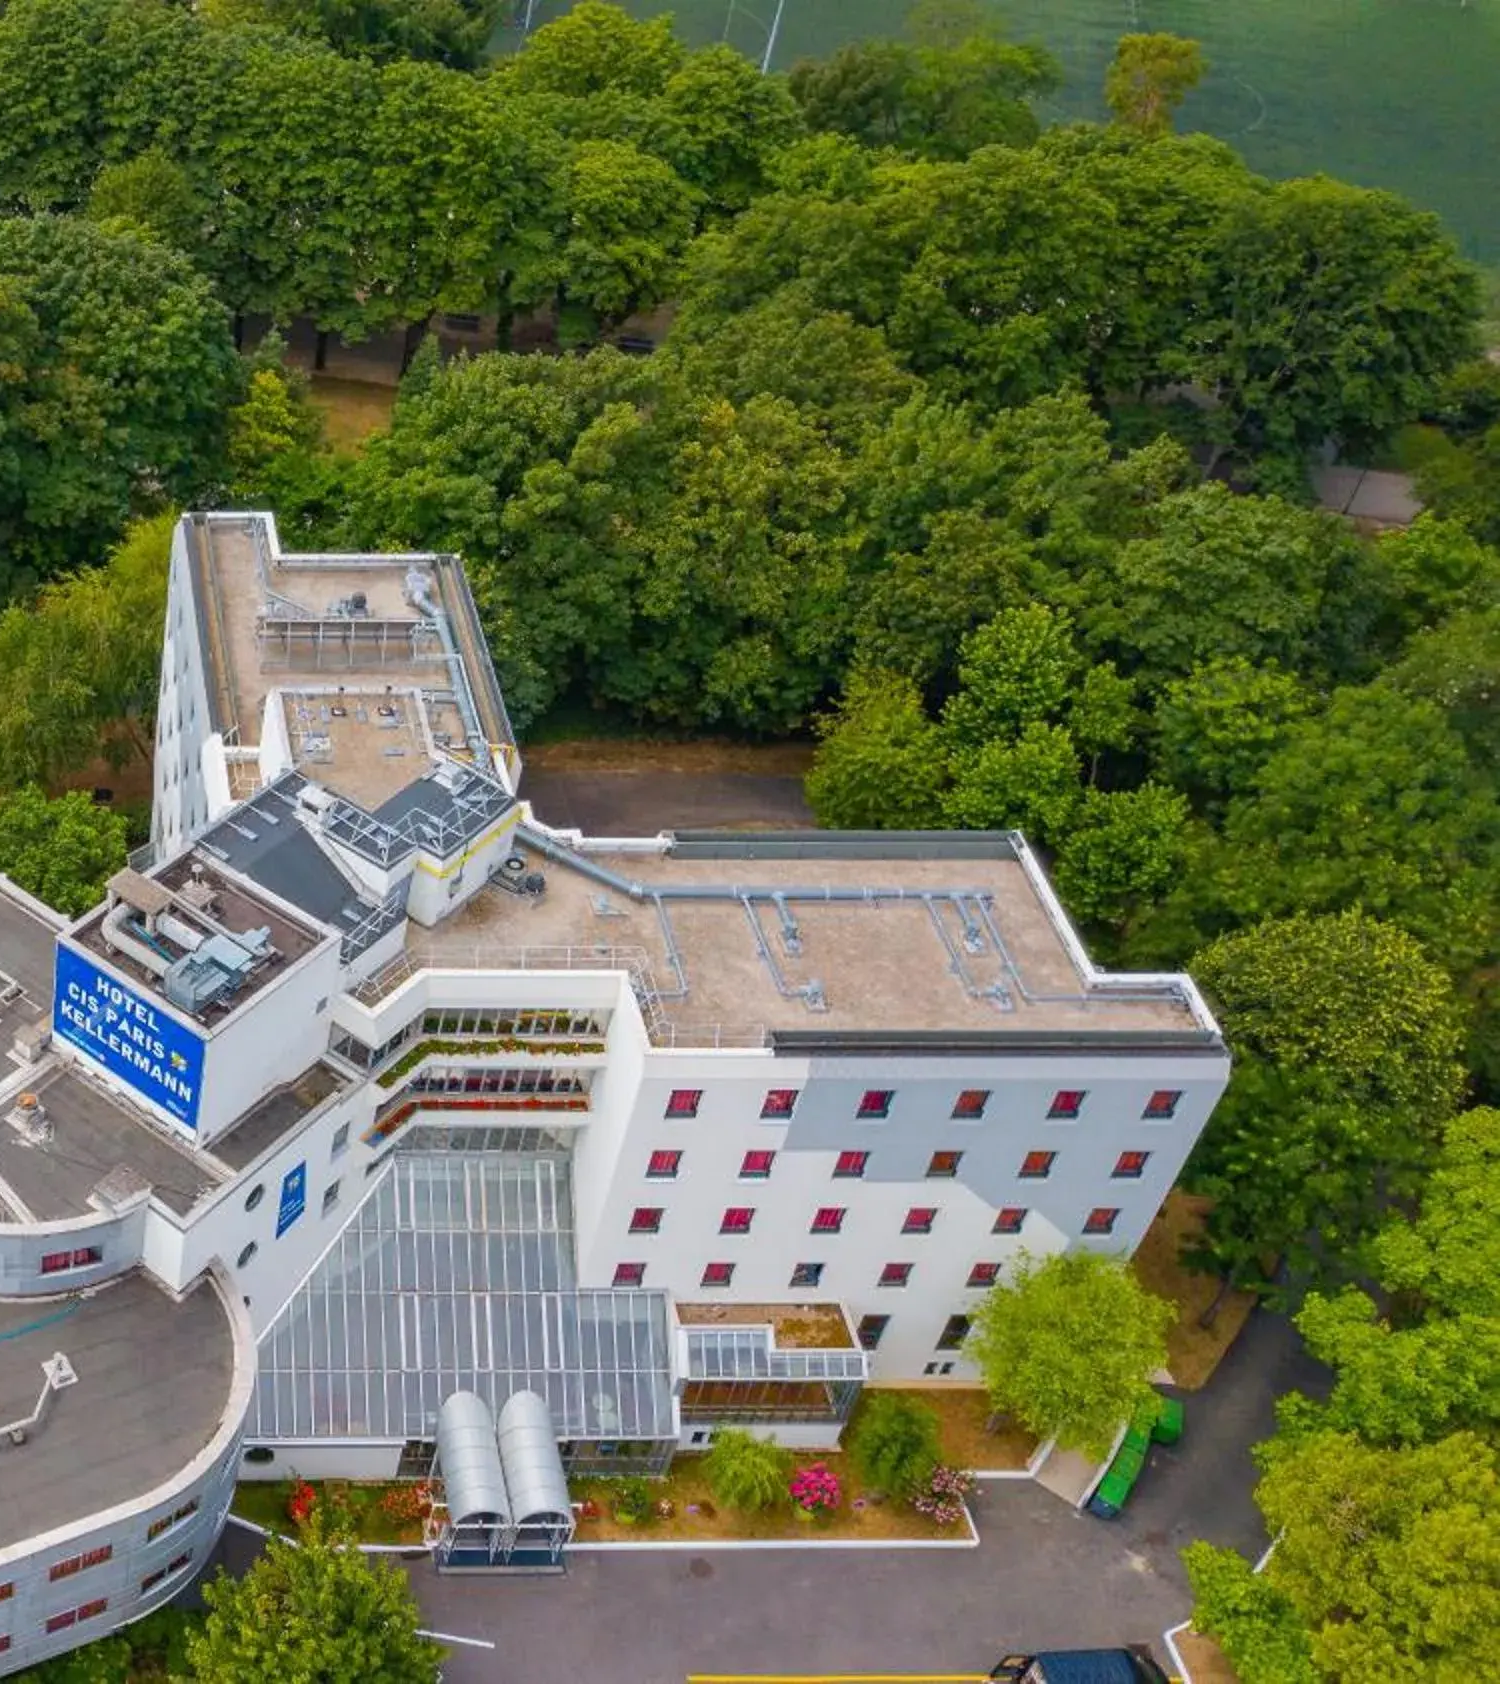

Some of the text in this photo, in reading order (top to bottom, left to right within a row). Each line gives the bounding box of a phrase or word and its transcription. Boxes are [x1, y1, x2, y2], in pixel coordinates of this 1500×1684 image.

[68, 982, 99, 1013] CIS
[105, 1007, 165, 1059] PARIS
[97, 976, 160, 1032] HOTEL
[61, 1000, 192, 1103] KELLERMANN
